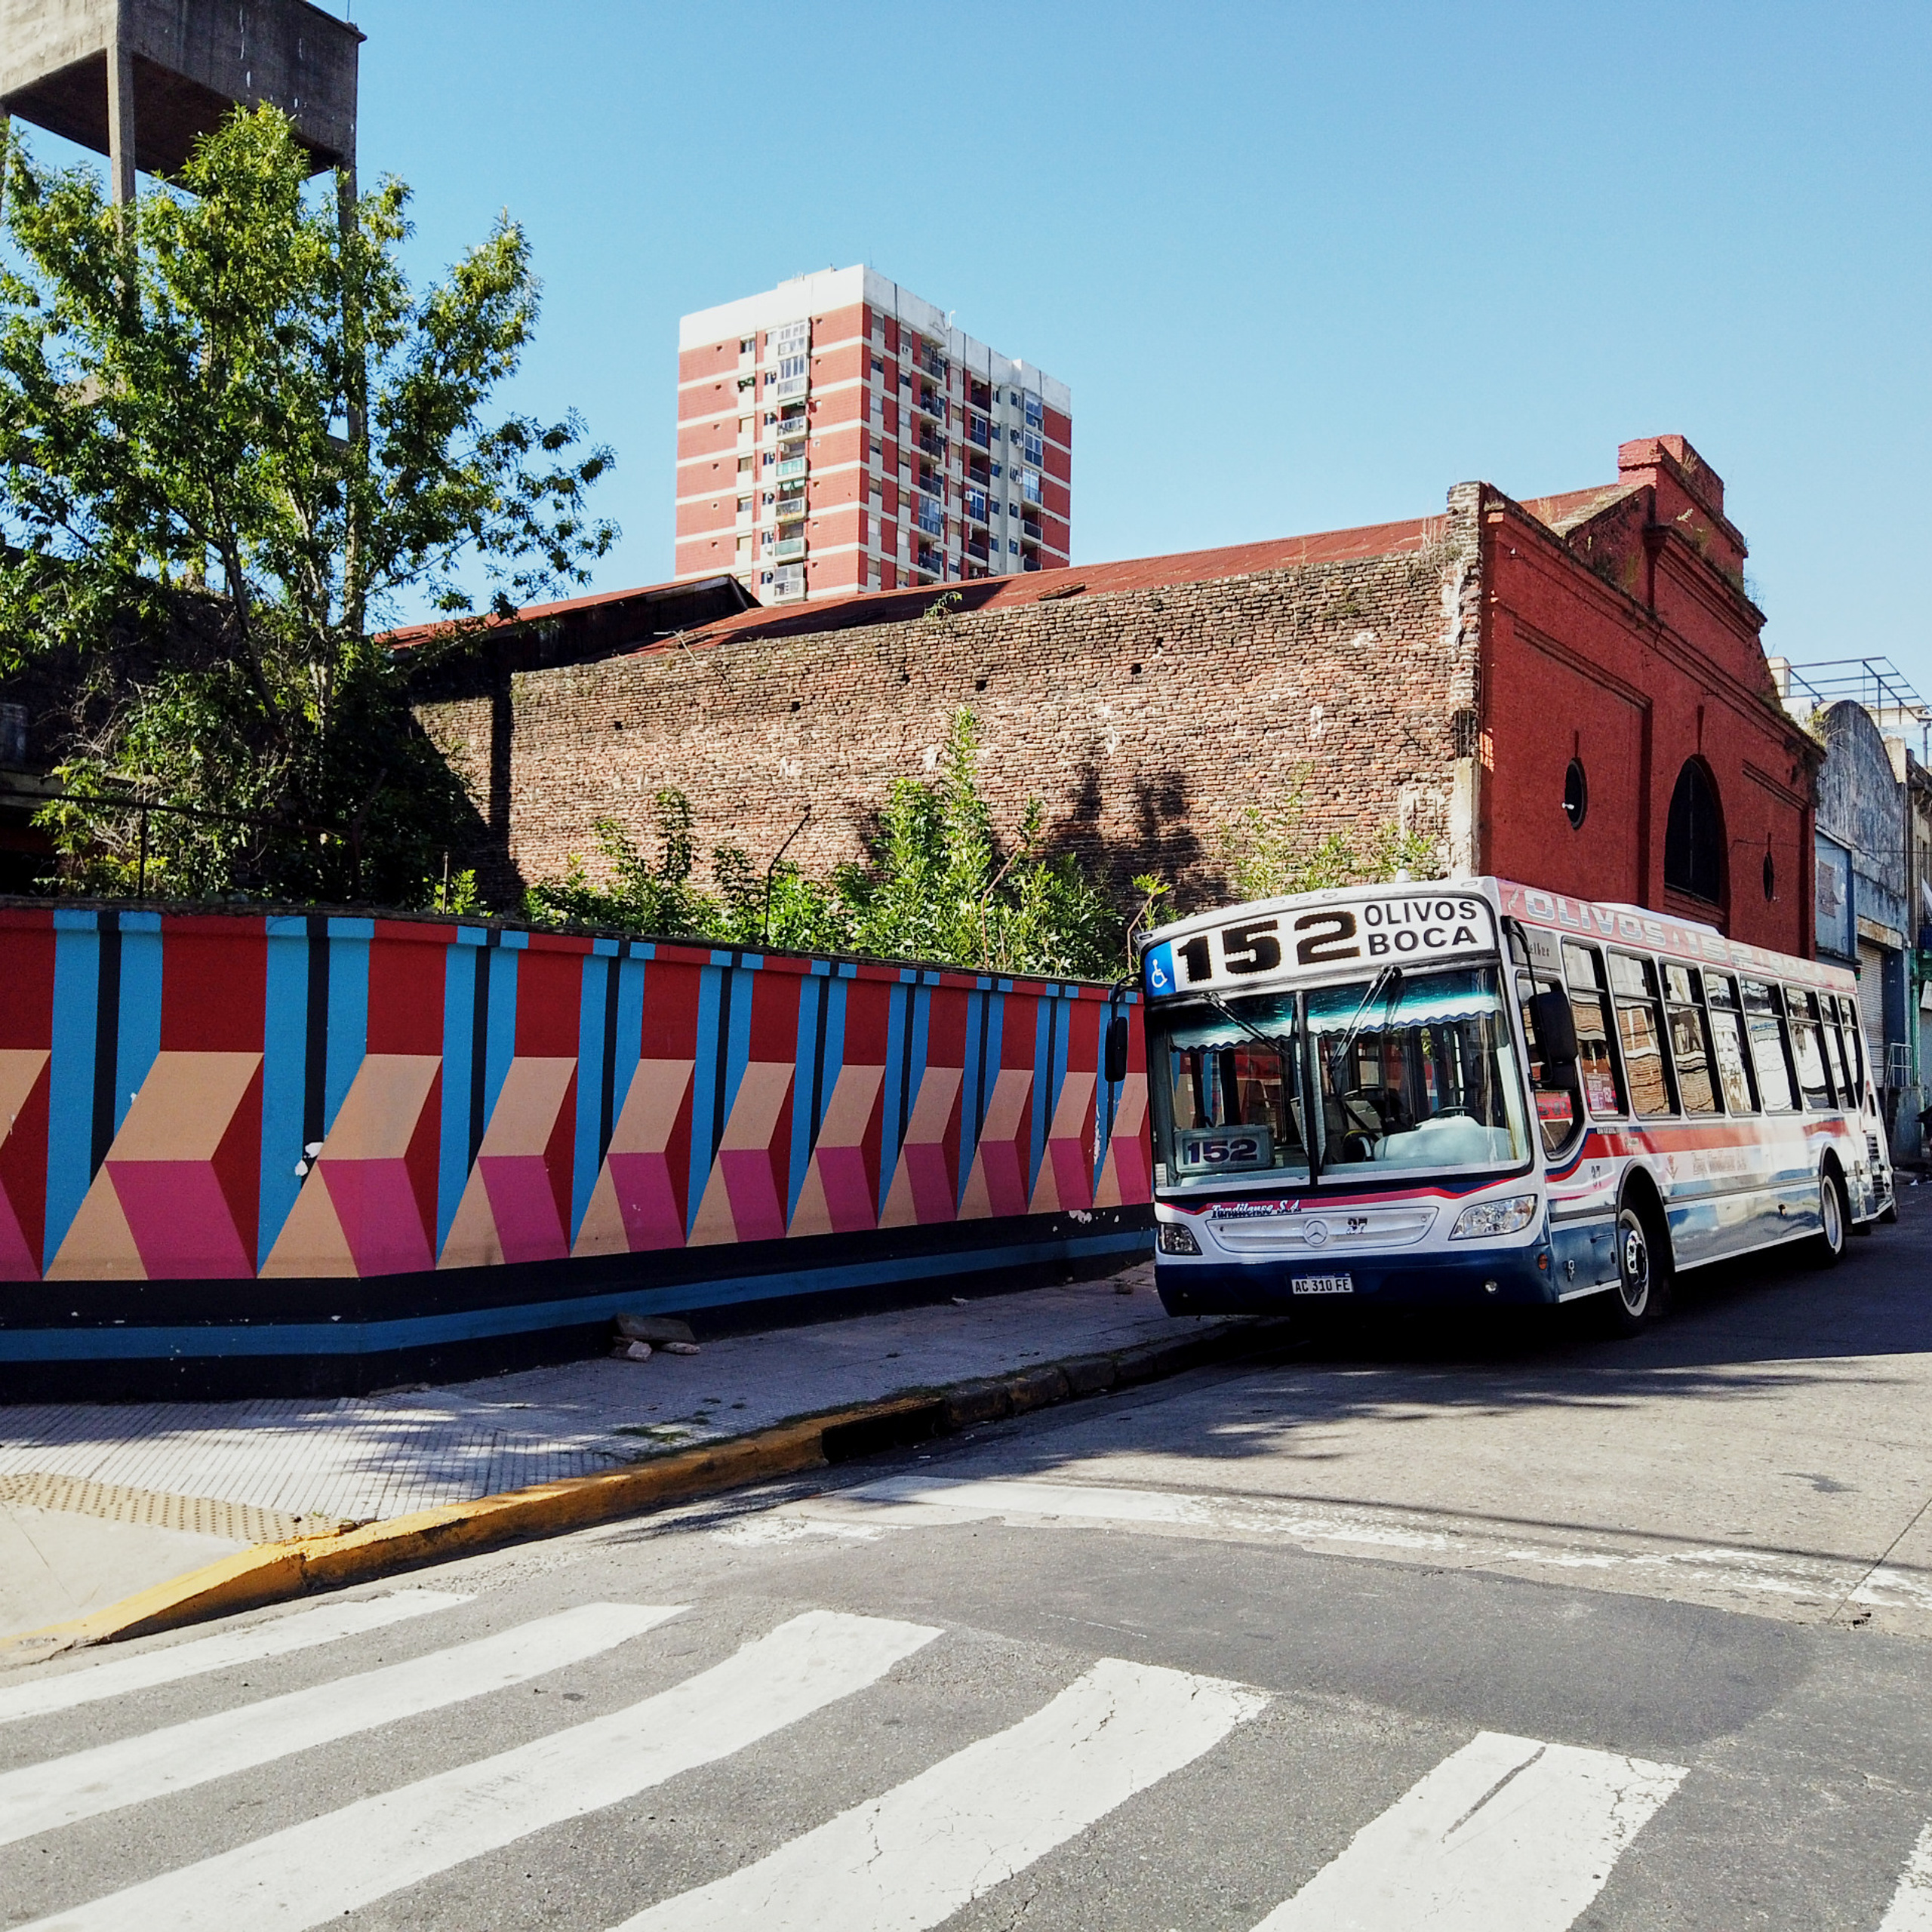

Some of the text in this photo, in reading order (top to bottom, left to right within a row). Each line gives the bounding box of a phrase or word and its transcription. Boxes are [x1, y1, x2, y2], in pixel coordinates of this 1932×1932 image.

[1364, 901, 1477, 927] OLIVOS
[1177, 910, 1360, 982] 152
[1368, 926, 1478, 956] BOCA
[1524, 889, 1827, 983] OLIVOS 152 BOCA
[1188, 1138, 1257, 1163] 152
[1295, 1278, 1350, 1293] AC 310 FE
